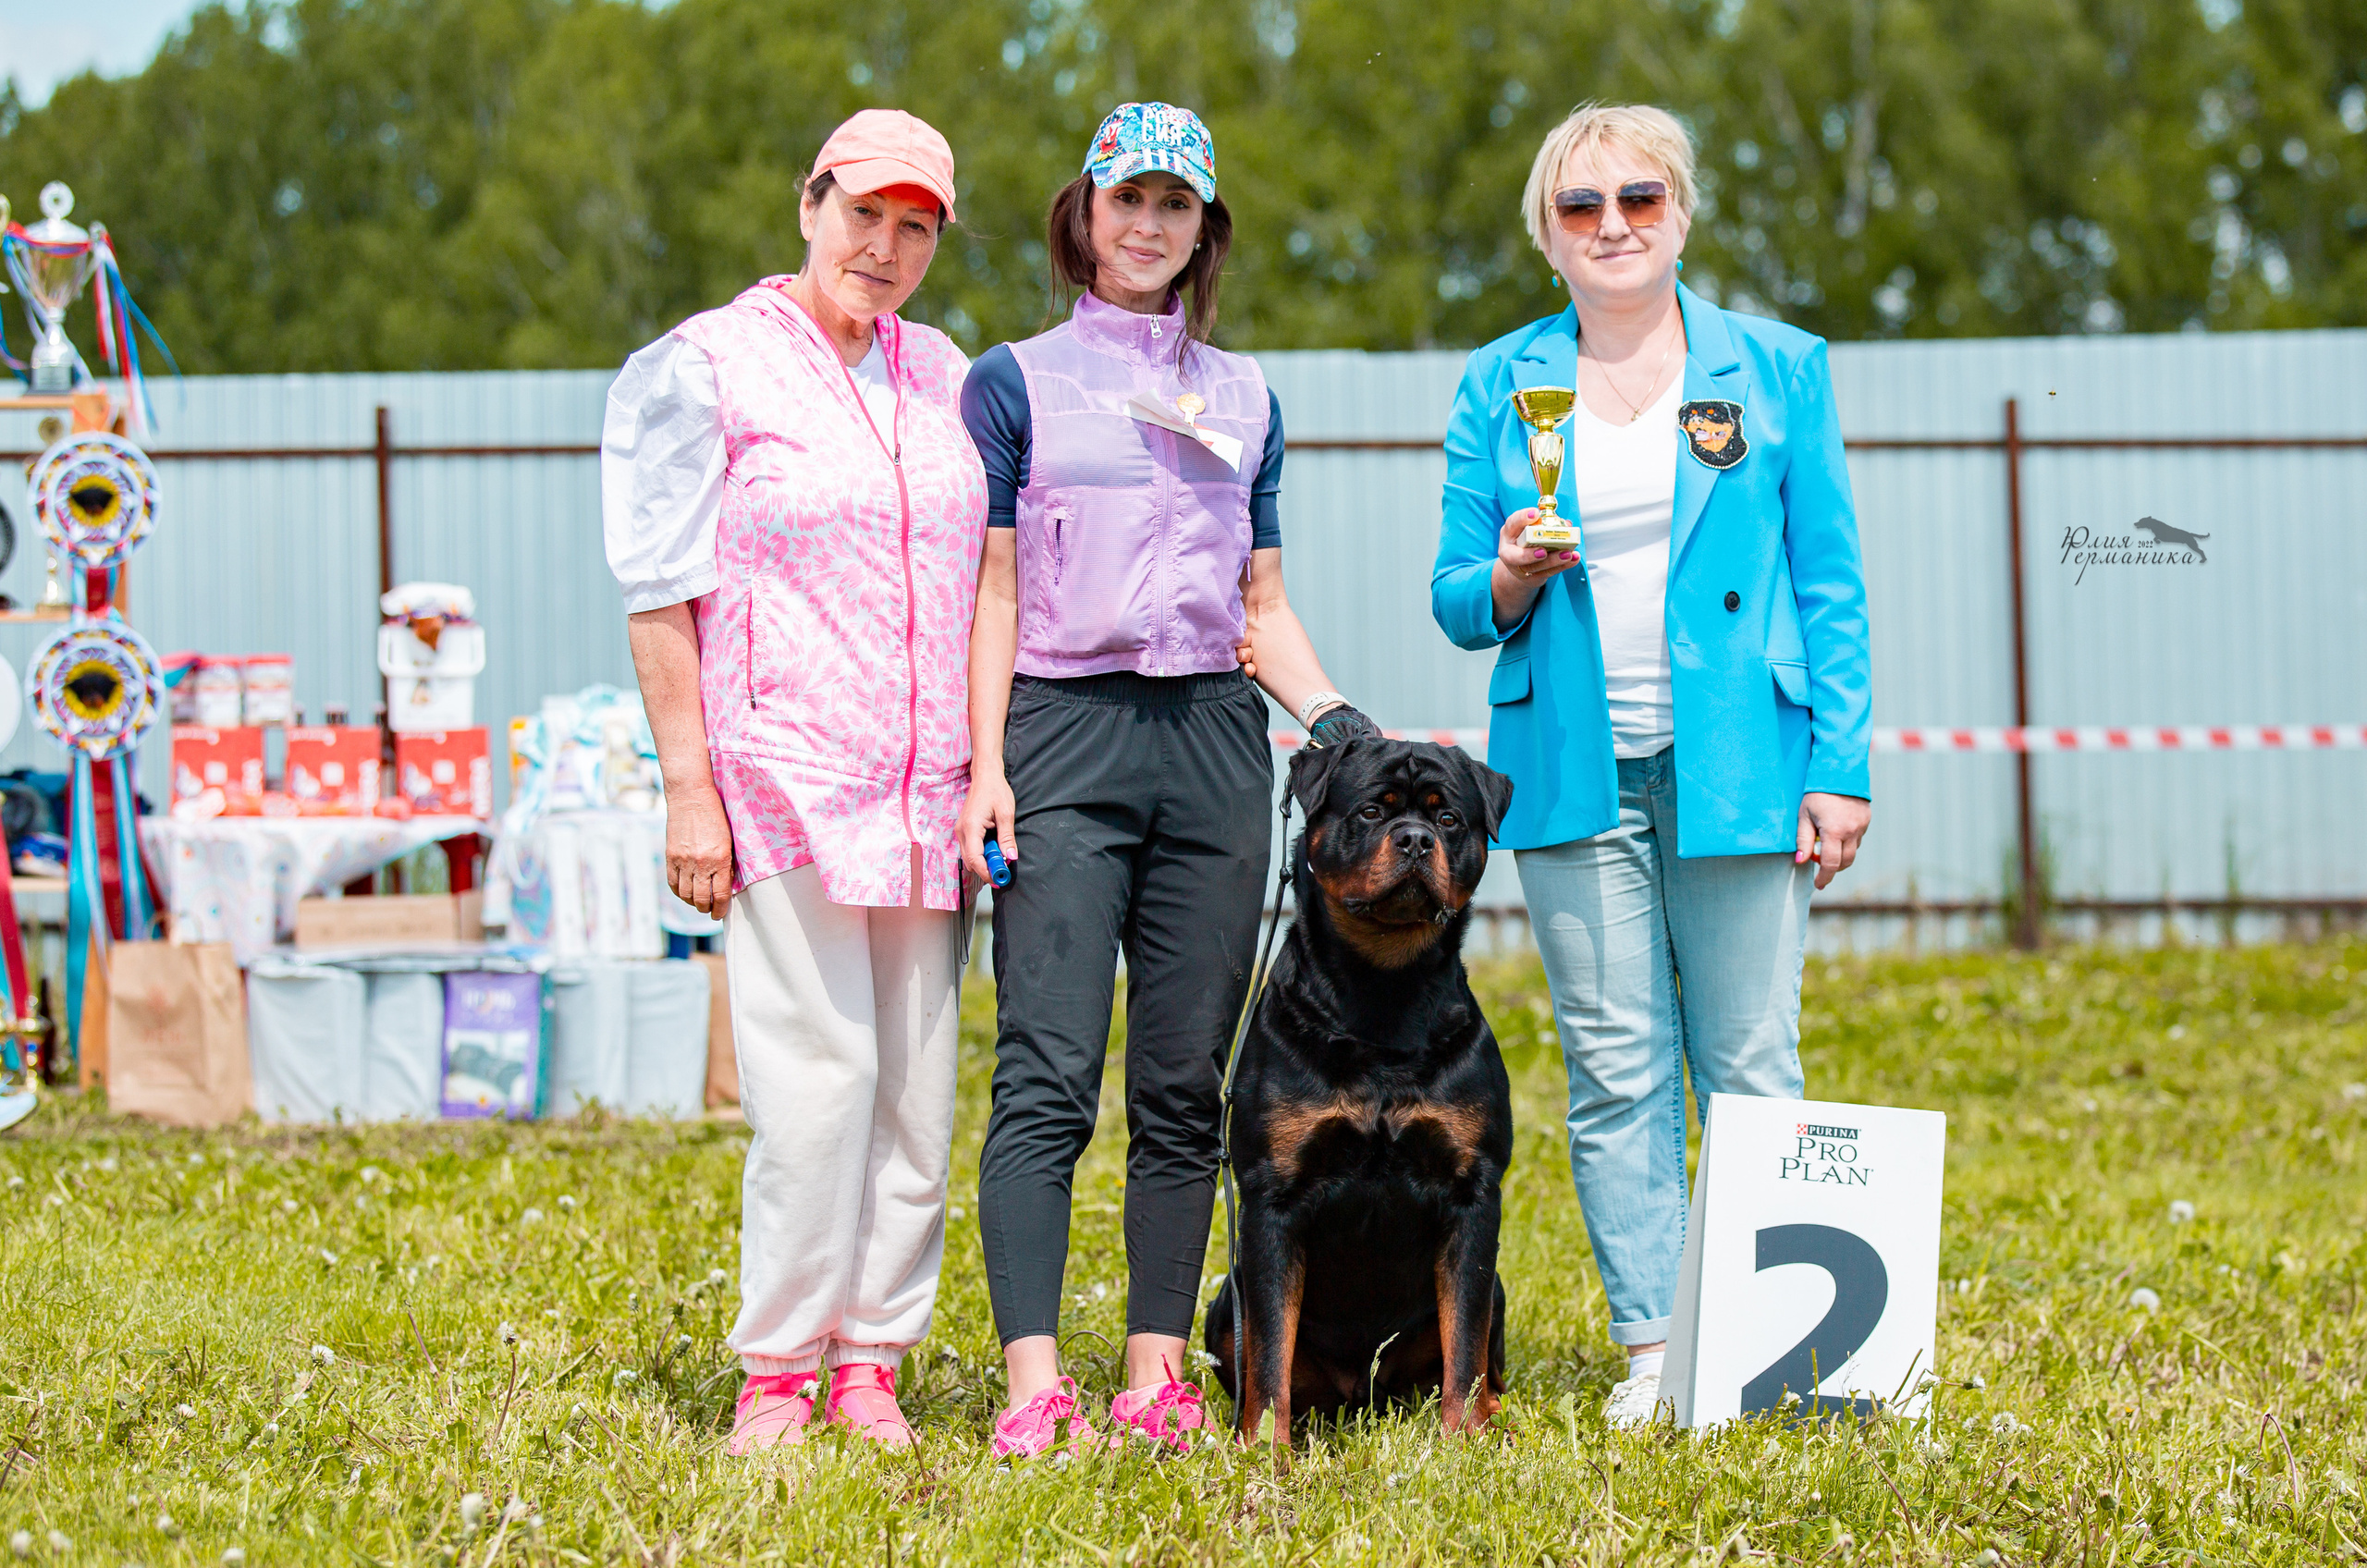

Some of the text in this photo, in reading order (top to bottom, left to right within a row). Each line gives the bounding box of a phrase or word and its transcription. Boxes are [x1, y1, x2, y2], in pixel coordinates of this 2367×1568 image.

[1142, 123, 1183, 147] СИЯ
[1809, 1125, 1857, 1138] PURINA
[1795, 1136, 1858, 1163] PRO
[1779, 1157, 1870, 1186] PLAN
[1740, 1223, 1889, 1432] 2
